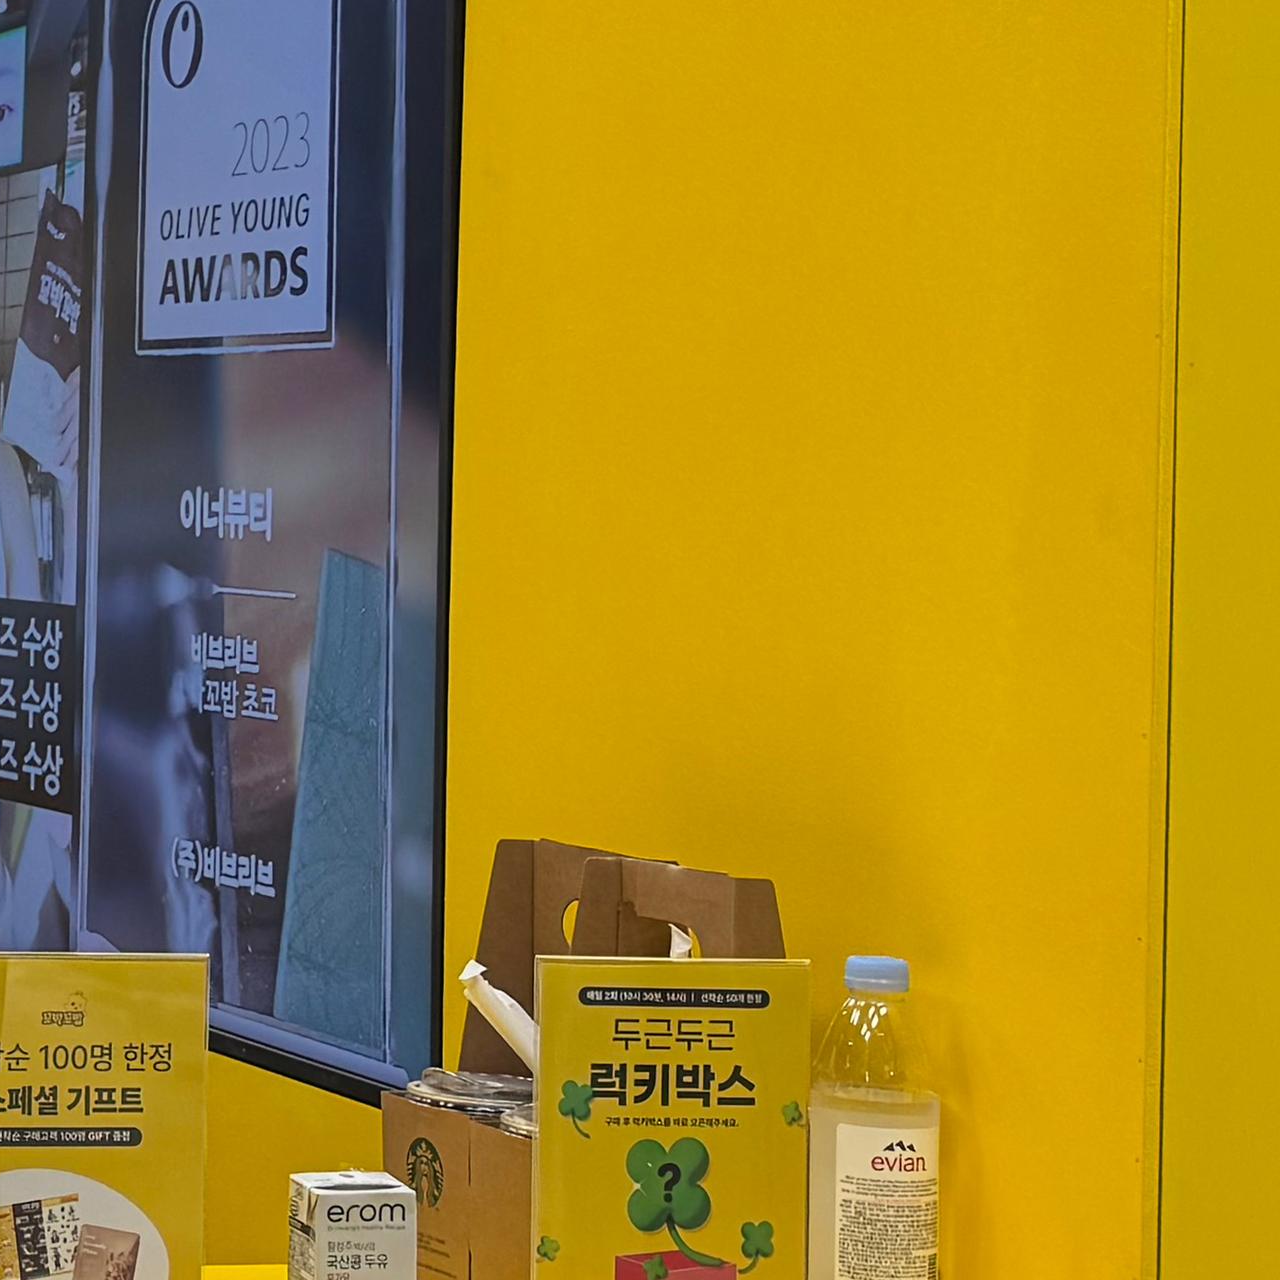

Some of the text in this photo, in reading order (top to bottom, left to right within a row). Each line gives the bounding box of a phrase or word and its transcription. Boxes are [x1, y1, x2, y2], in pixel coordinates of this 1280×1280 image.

[232, 111, 311, 177] 2023
[160, 192, 310, 242] OLIVE YOUNG
[159, 245, 309, 305] AWARDS
[179, 484, 274, 542] 이너뷰티
[22, 617, 63, 670] 수상
[191, 632, 259, 674] 비브리브
[21, 679, 62, 733] 수상
[241, 683, 279, 721] 초코
[22, 741, 63, 796] 수상
[170, 836, 275, 898] (주)비브리브
[612, 1019, 735, 1051] 두근두근
[38, 1042, 113, 1072] 100명
[123, 1042, 173, 1072] 한정
[66, 1085, 144, 1116] 기프트
[591, 1063, 756, 1108] 럭키박스
[88, 1132, 111, 1142] GIFT
[871, 1153, 927, 1172] evian
[327, 1203, 406, 1223] erom
[327, 1254, 389, 1270] 국산콩 두유
